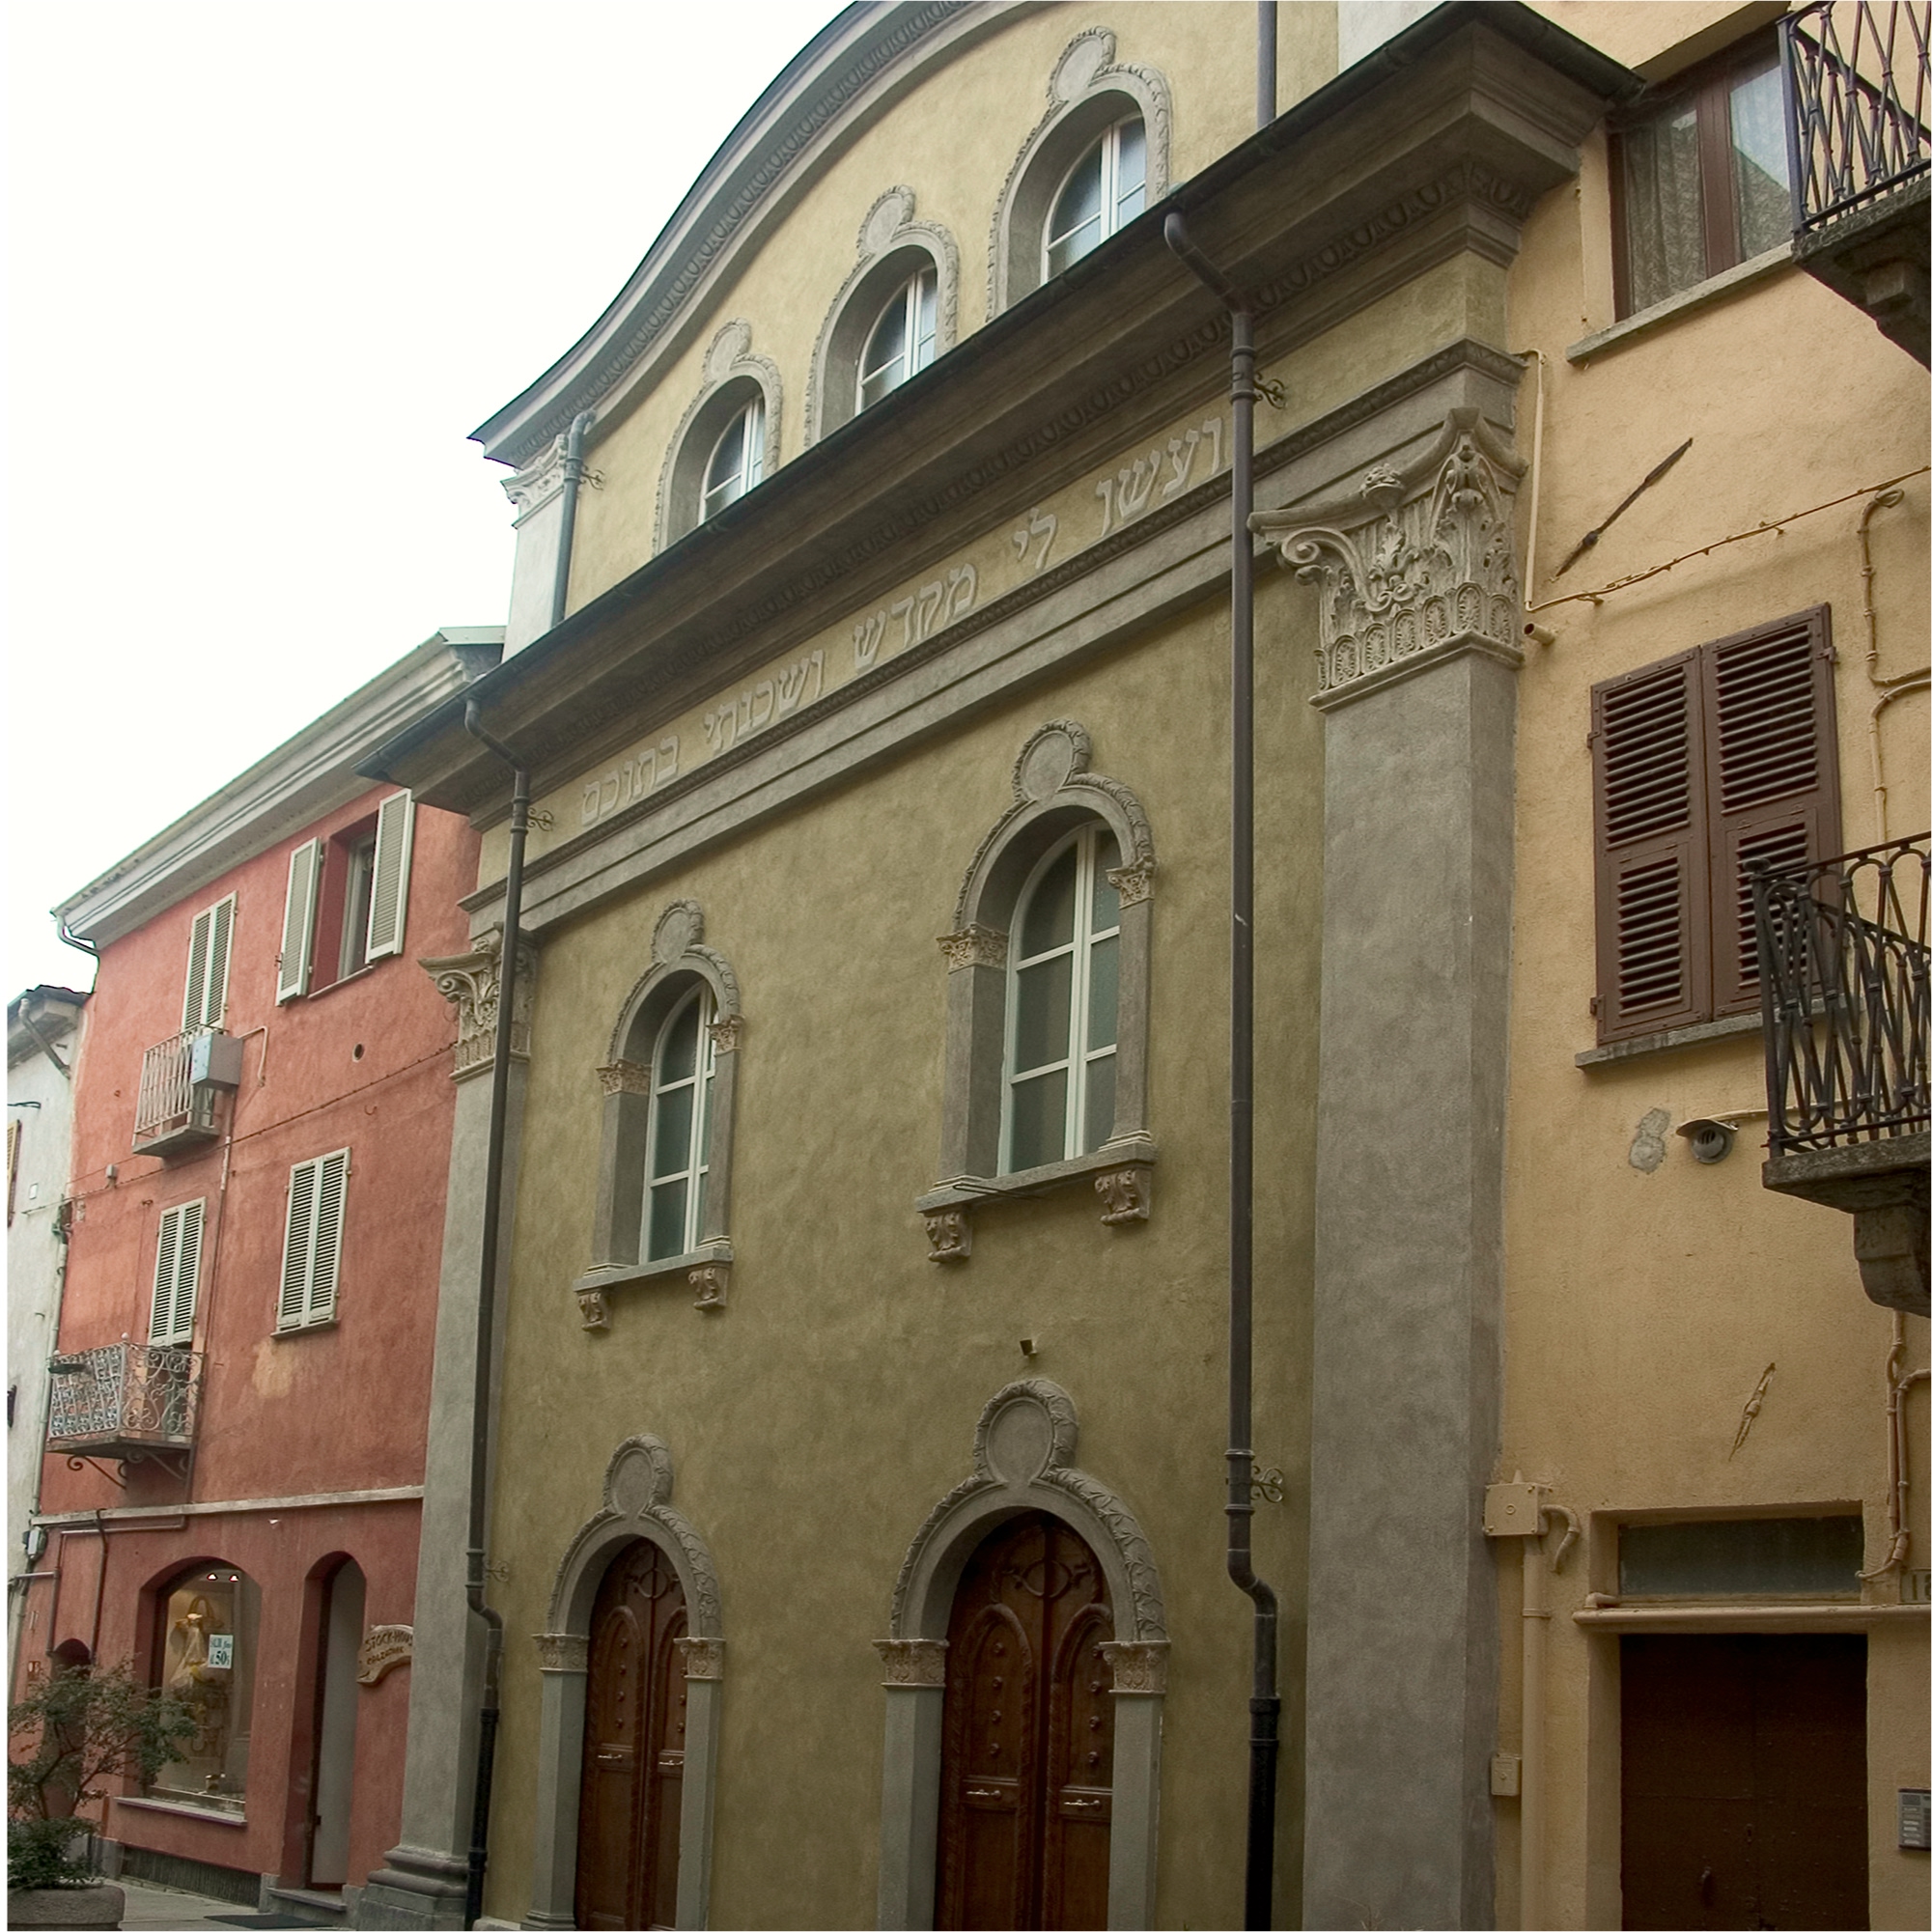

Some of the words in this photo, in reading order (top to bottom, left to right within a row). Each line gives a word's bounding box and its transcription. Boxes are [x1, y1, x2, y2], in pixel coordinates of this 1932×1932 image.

[1013, 507, 1057, 569] לי
[854, 563, 976, 669] מקדש
[704, 649, 825, 751] ושכנתי
[580, 735, 679, 826] בתוכם
